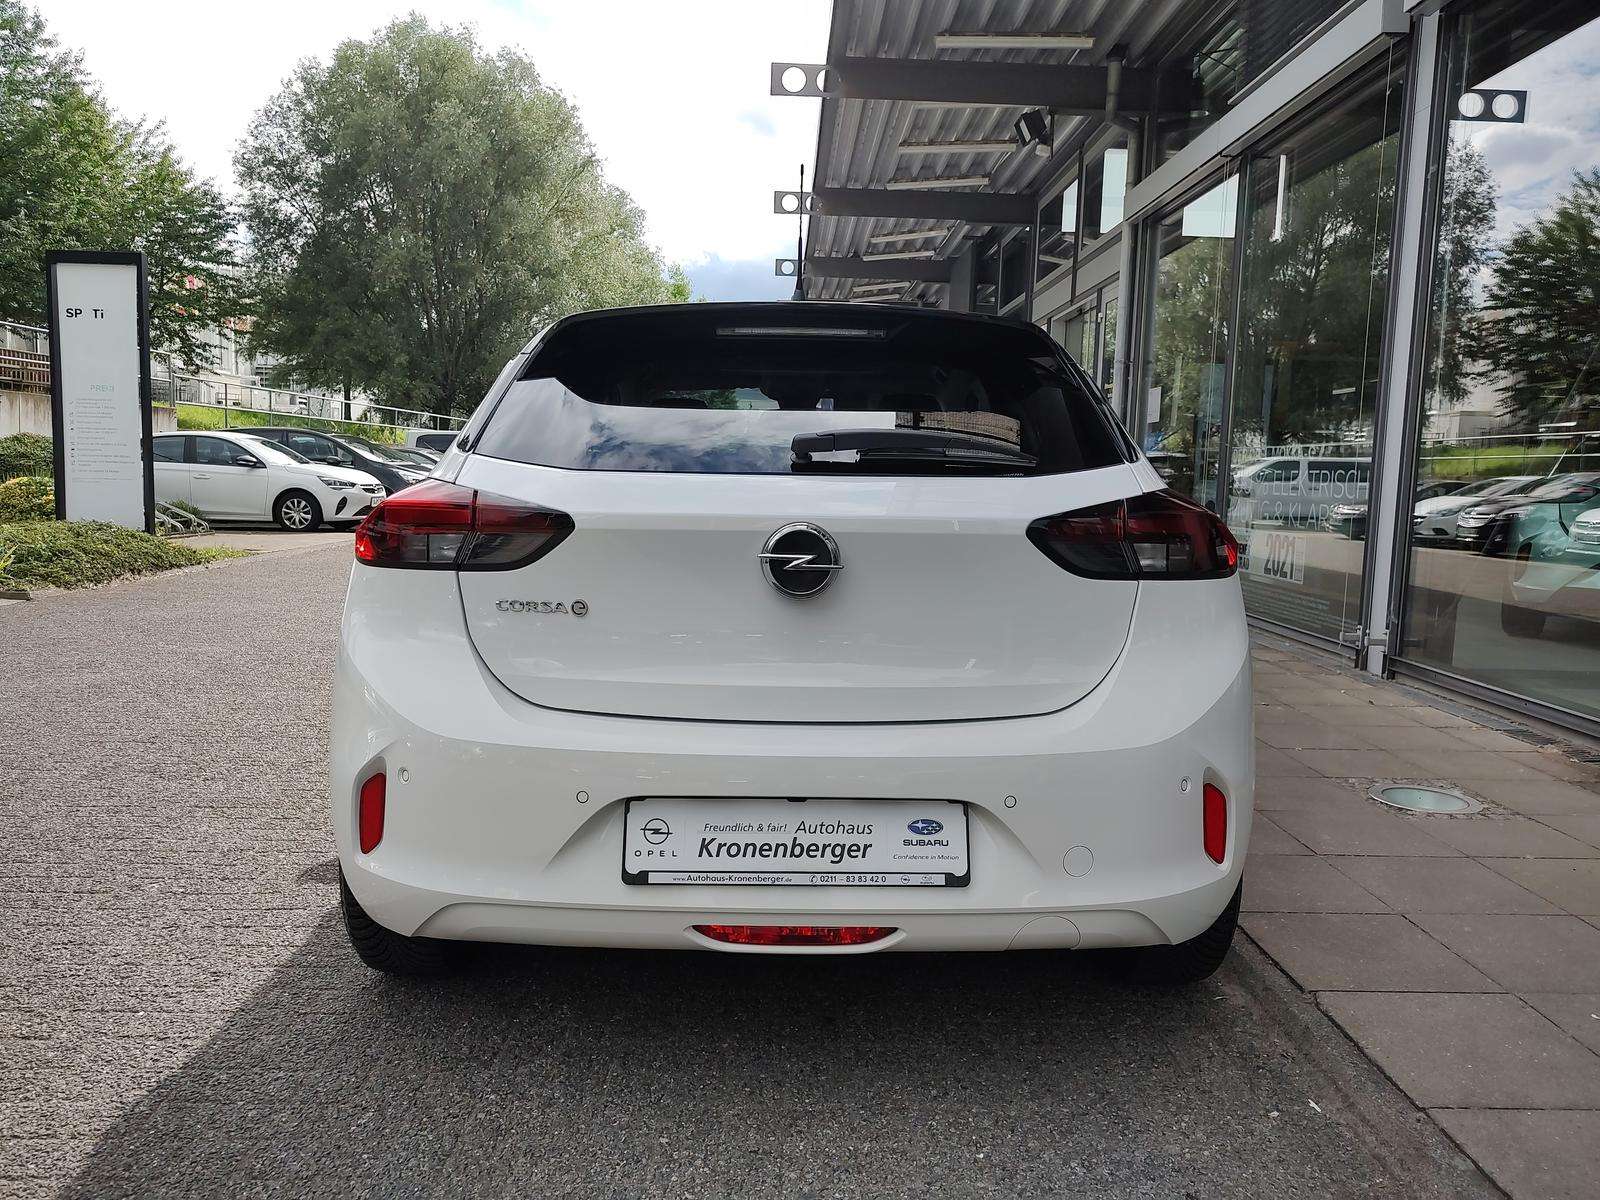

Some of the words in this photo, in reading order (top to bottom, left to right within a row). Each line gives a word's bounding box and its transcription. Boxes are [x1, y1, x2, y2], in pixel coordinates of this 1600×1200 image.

[1273, 469, 1369, 499] ELEKTRISCH
[1273, 501, 1284, 523] &
[1264, 534, 1297, 579] 2021
[496, 600, 569, 613] CORSA
[704, 823, 753, 832] Freundlich
[756, 823, 764, 832] &
[766, 823, 787, 833] fair!
[795, 820, 873, 835] Autohaus
[698, 837, 872, 864] Kronenberger
[672, 874, 792, 884] www.Autohaus-Kronenberger.de
